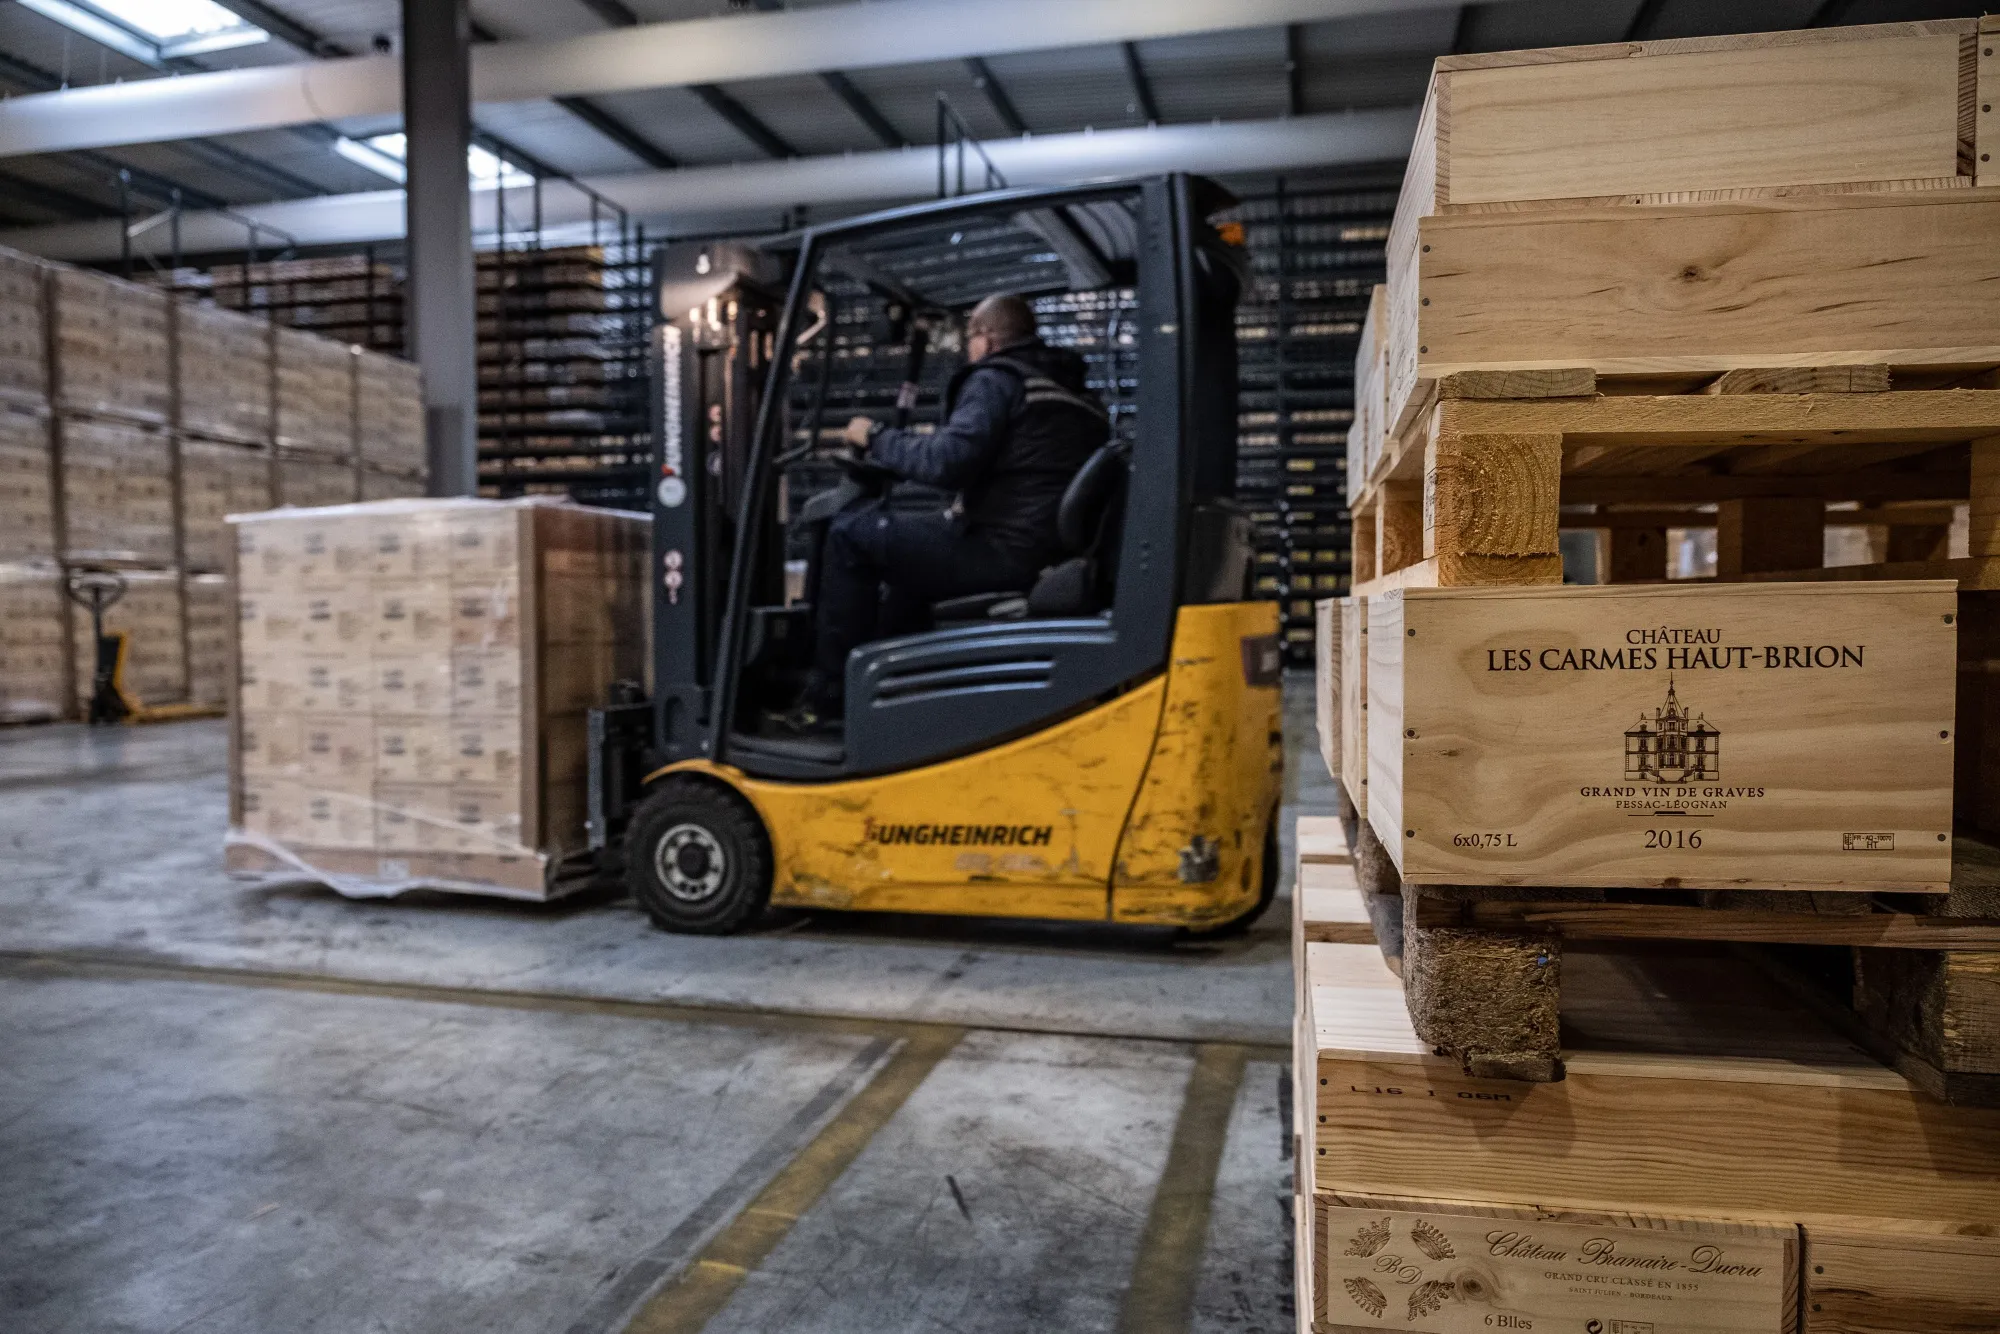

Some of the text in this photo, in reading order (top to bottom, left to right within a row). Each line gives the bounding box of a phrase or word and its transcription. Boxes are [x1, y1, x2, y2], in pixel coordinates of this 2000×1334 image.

[1626, 626, 1722, 645] CHÂTEAU
[1487, 645, 1866, 671] LES CARMES HAUT-BRION
[1580, 787, 1765, 798] GRAND VIN DE GRAVES
[1616, 800, 1728, 809] PESSAC-LÉOGNAN
[1453, 833, 1518, 849] 6x0,75 L
[1644, 830, 1702, 849] 2016
[1866, 841, 1879, 849] HT
[1486, 1230, 1764, 1278] Château Branaire-Ducru
[1544, 1271, 1699, 1291] GRAND CRU CLASSÉ EN 1855
[1568, 1286, 1592, 1294] SAINT
[1630, 1292, 1672, 1301] BORDEAUX
[1484, 1314, 1493, 1326] 6
